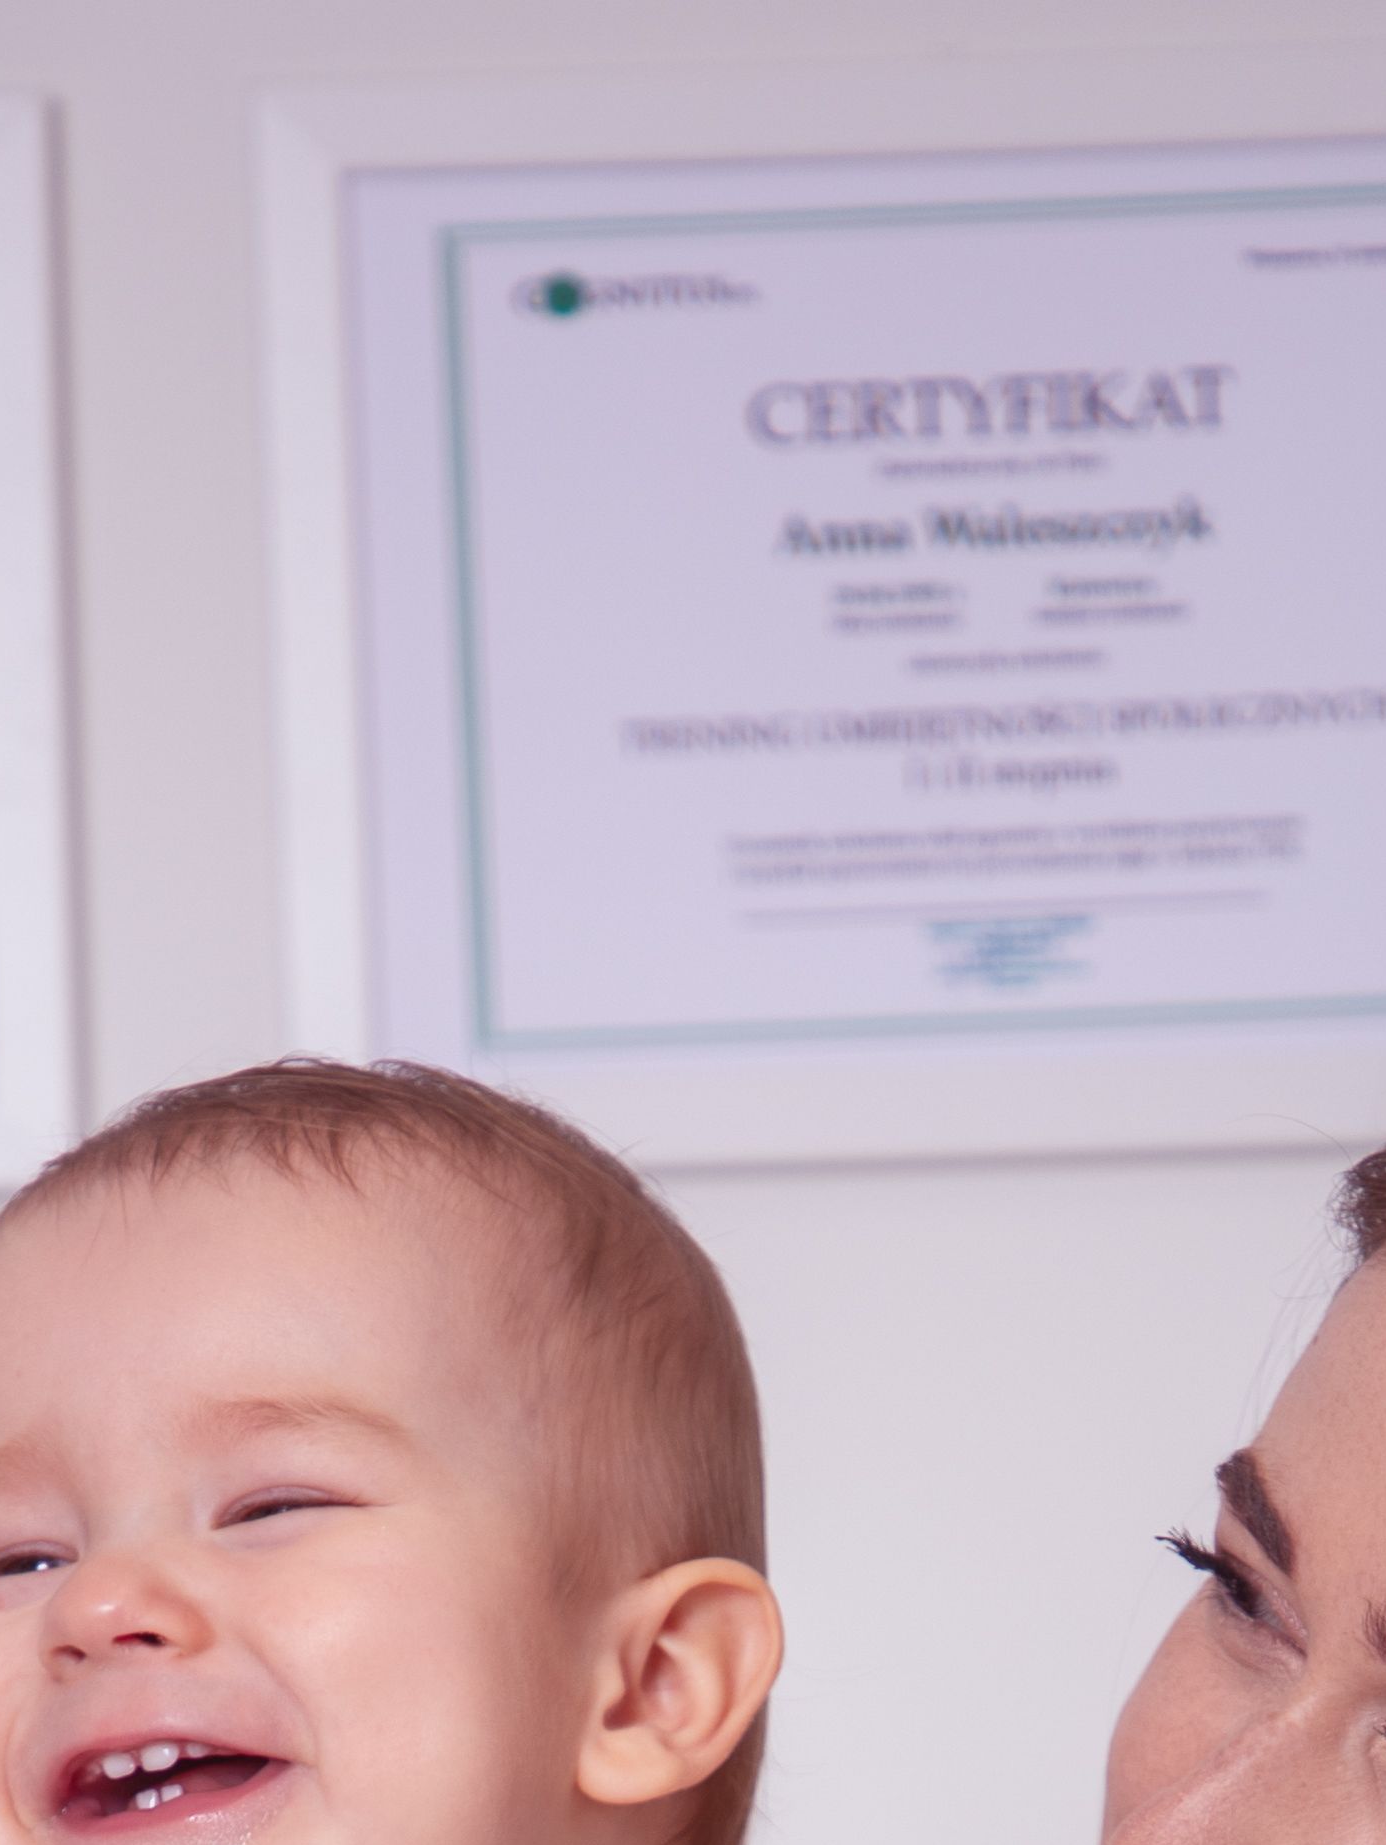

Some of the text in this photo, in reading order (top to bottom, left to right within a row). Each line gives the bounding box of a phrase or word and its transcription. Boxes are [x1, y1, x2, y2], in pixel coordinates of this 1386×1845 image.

[745, 365, 1238, 447] CERTYFIKAT
[777, 490, 1215, 559] Anna Waleszczyk
